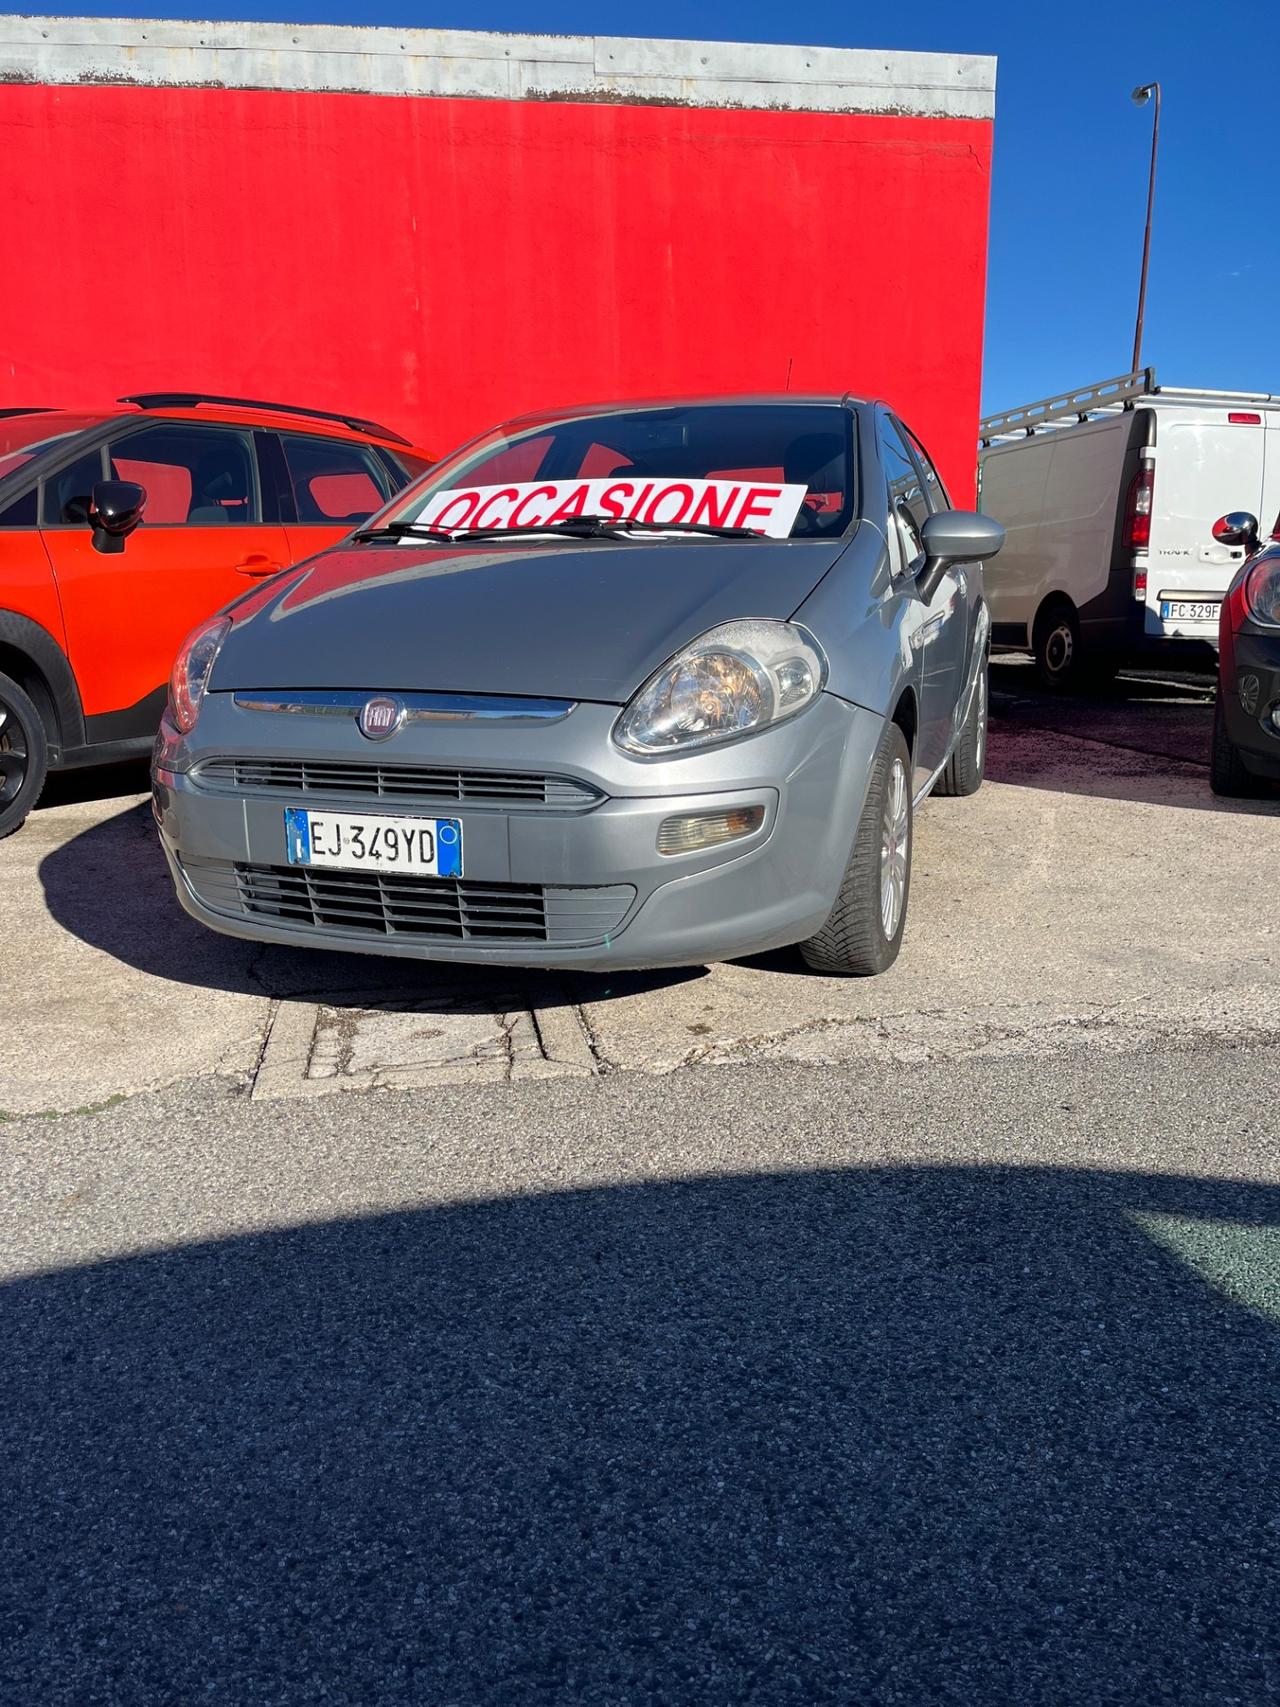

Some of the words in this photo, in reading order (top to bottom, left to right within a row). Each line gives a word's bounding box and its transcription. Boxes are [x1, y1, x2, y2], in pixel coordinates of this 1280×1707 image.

[428, 483, 782, 535] OCCASIONE
[1189, 604, 1219, 618] 329F
[368, 706, 394, 727] FIAT
